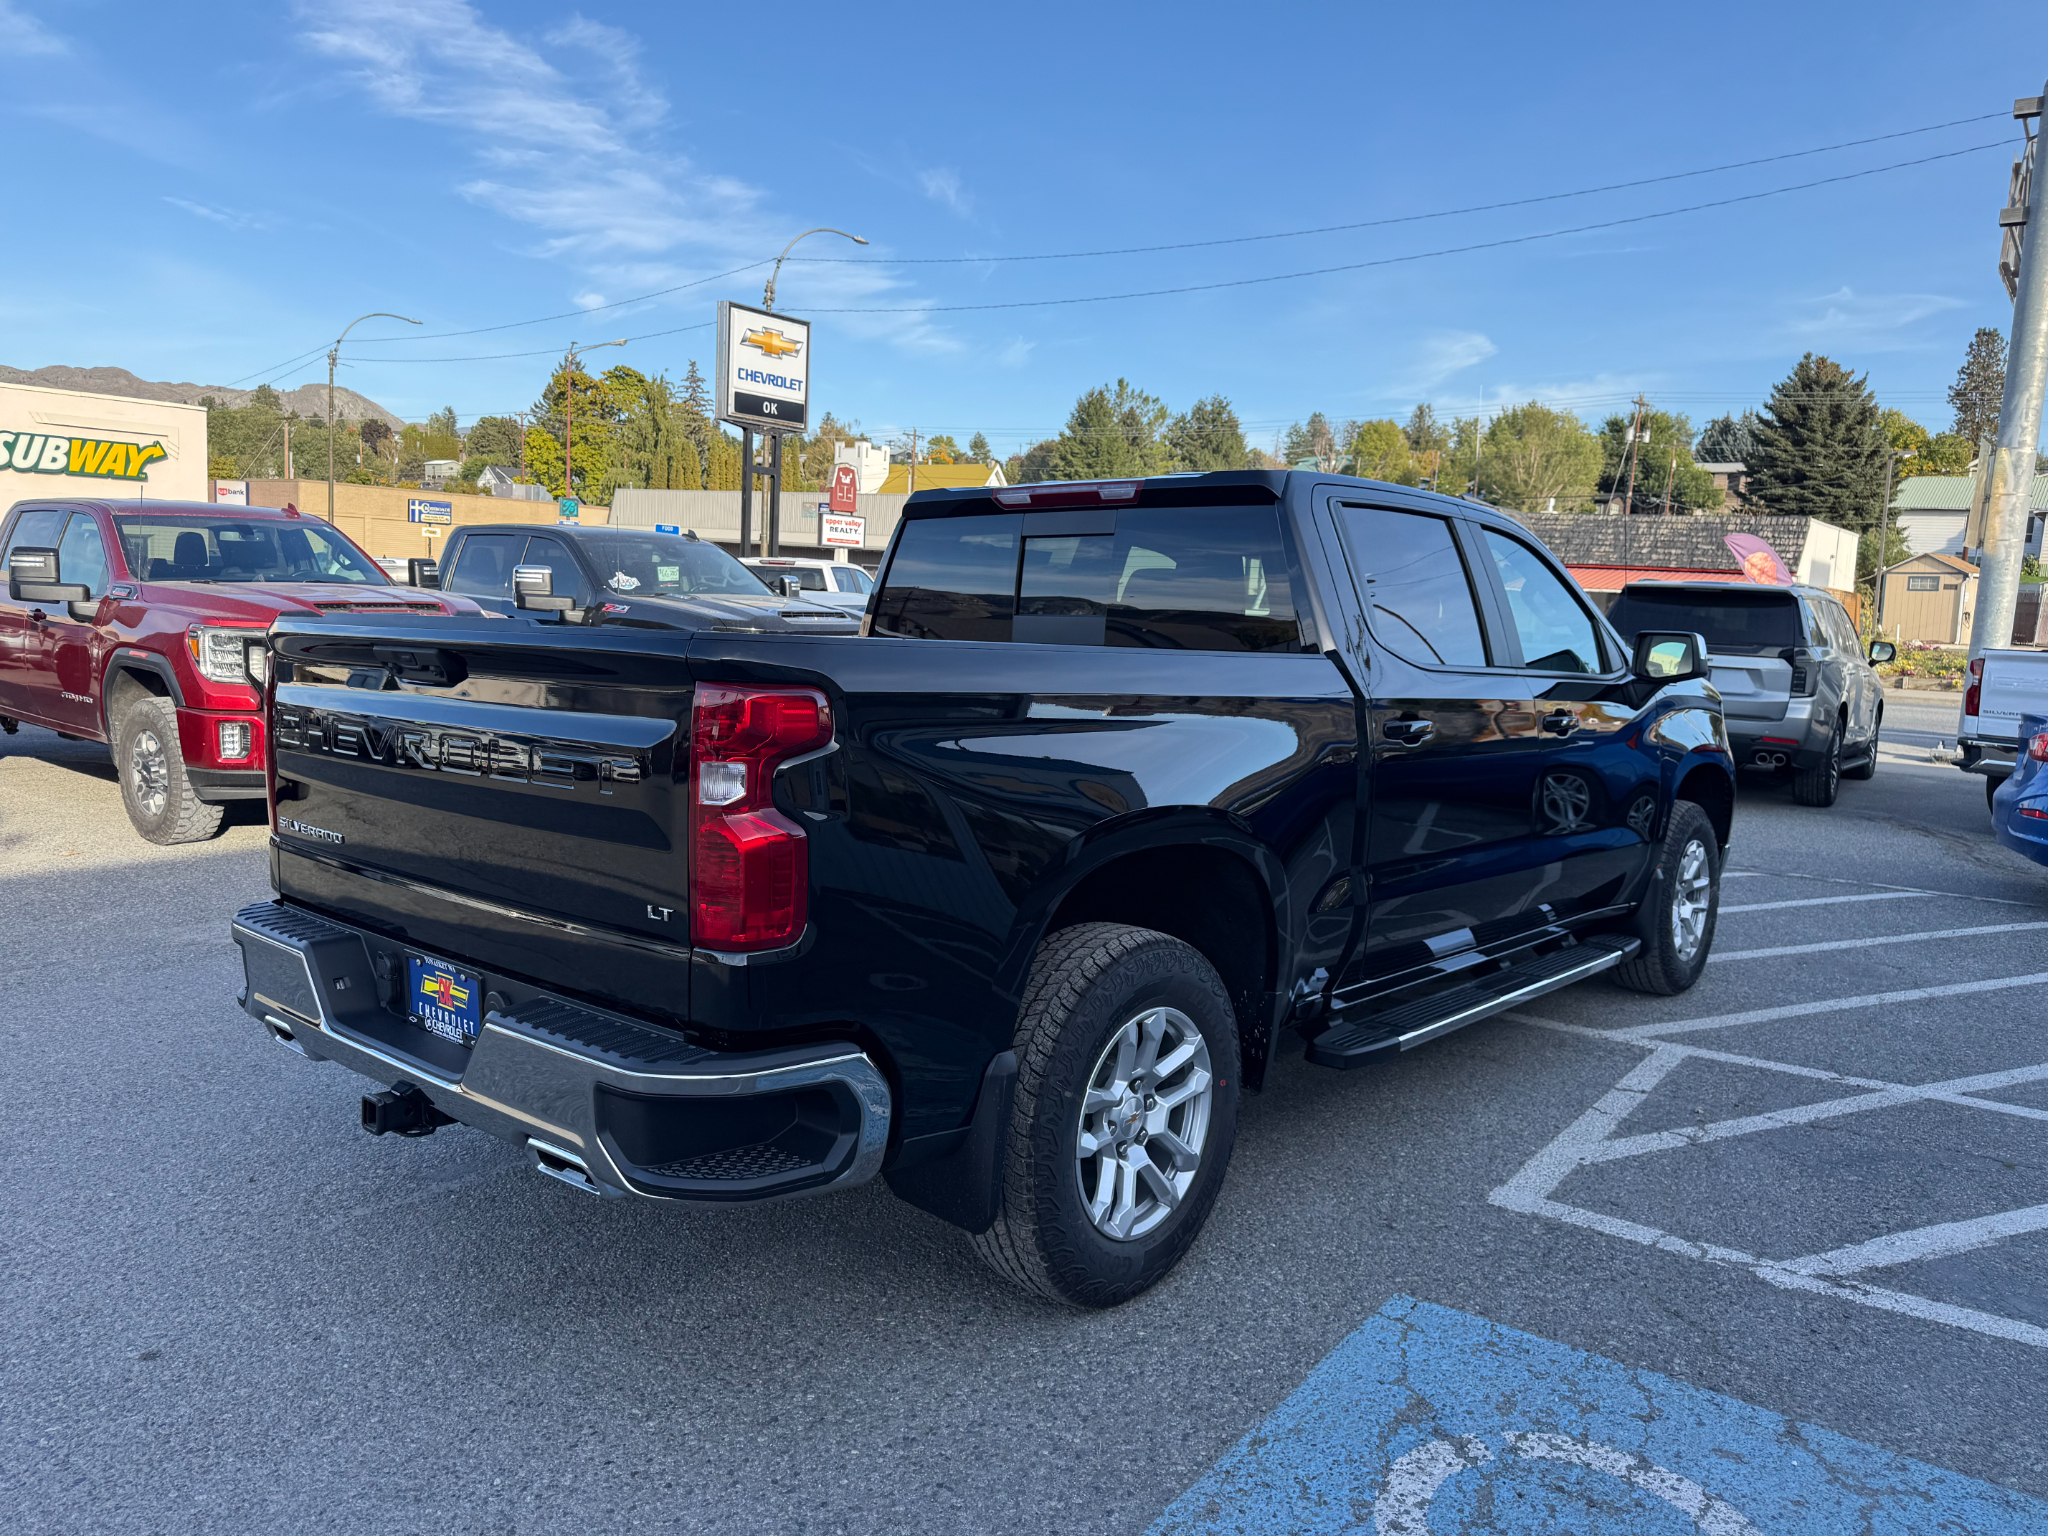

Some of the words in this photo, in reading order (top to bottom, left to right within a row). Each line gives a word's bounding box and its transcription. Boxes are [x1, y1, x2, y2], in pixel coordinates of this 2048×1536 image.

[738, 367, 803, 391] CHEVROLET
[763, 401, 778, 415] OK
[0, 431, 165, 477] SUBWAY
[829, 526, 859, 535] REALTY
[276, 707, 641, 795] CHEVROLET
[279, 816, 346, 844] SILVERADO
[647, 904, 675, 922] LT
[419, 1002, 474, 1034] CHEVROLET
[432, 1019, 463, 1040] CHEVROLET
